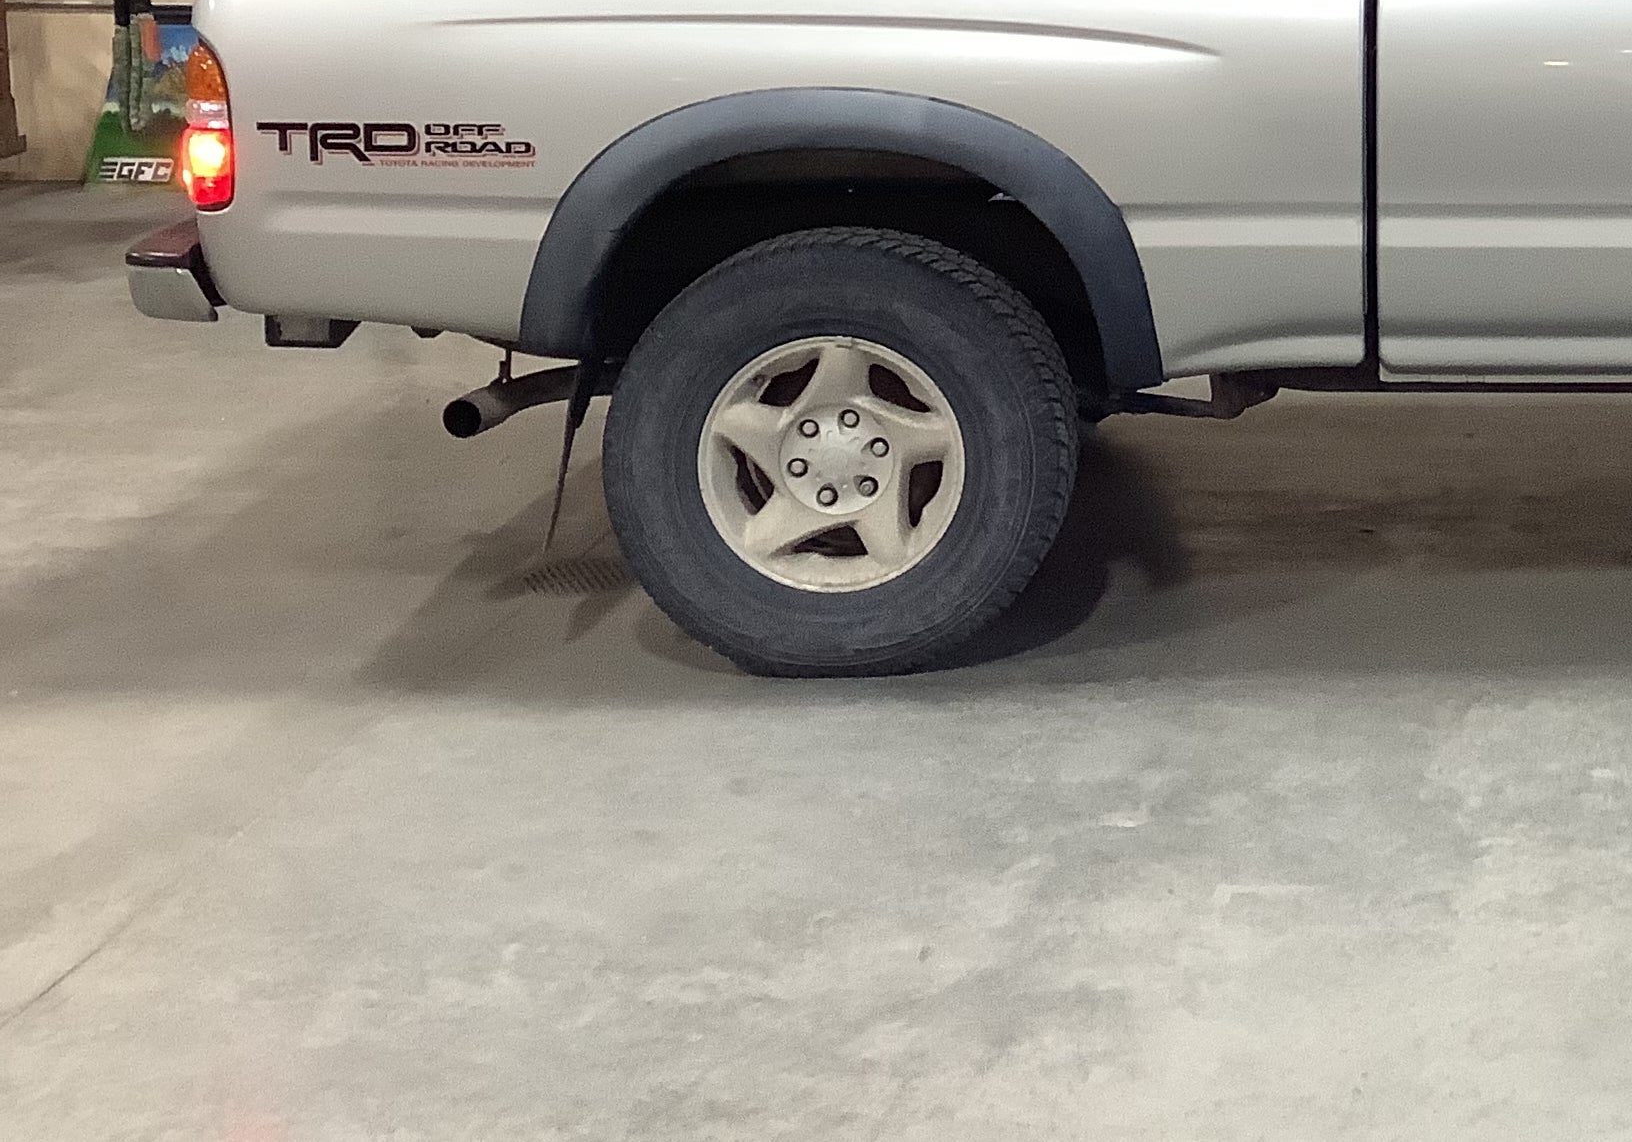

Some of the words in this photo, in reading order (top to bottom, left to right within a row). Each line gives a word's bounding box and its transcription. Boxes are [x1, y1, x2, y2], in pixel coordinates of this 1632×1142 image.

[424, 123, 505, 139] OFF
[256, 122, 420, 165] TRD
[424, 140, 537, 157] ROAD
[110, 159, 174, 182] GFC
[379, 159, 418, 168] TOYOTA
[420, 159, 460, 168] RACING
[462, 159, 536, 168] DEVELOPMENT
